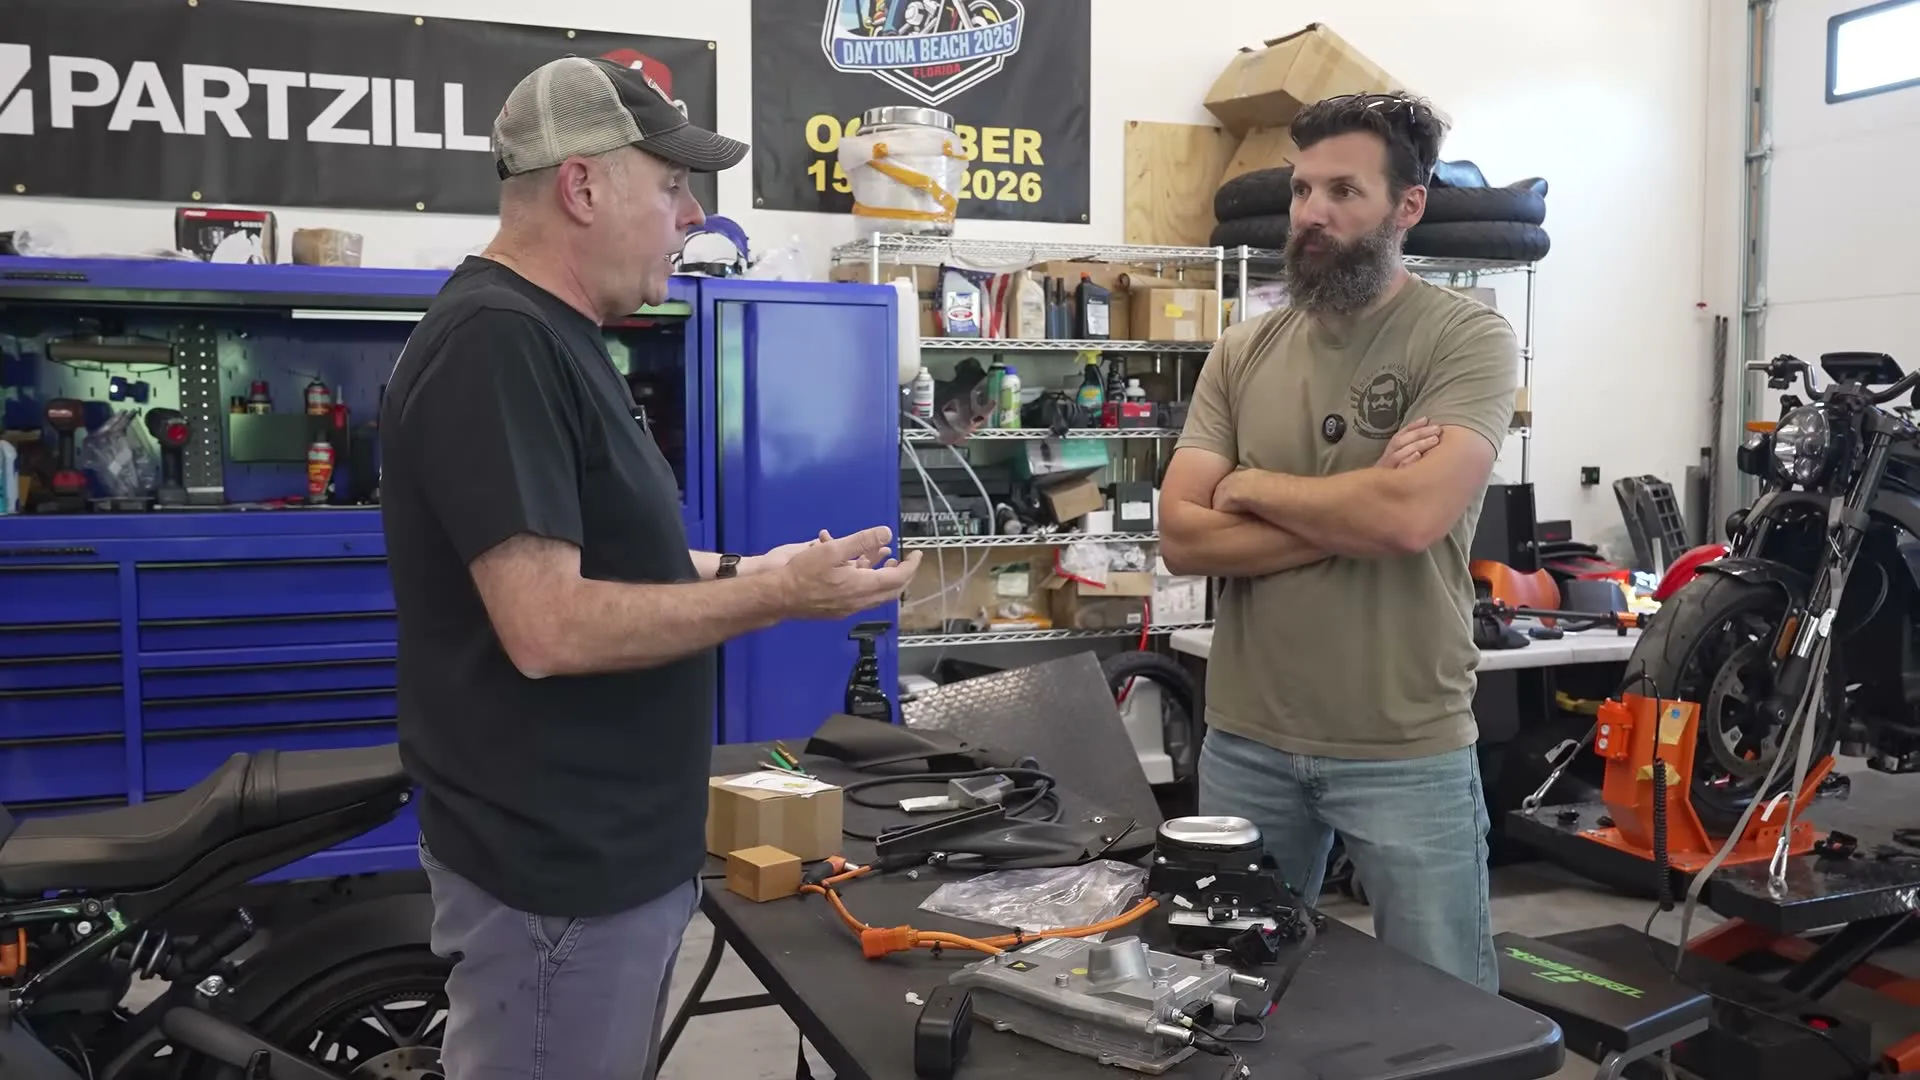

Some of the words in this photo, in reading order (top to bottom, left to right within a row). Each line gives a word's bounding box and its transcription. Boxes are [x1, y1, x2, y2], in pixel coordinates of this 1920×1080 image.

[842, 39, 916, 65] DAYTONA
[919, 33, 970, 62] BEACH
[973, 23, 1013, 54] 2026
[912, 63, 962, 78] FLORIDA
[48, 55, 494, 152] PARTZILL
[805, 114, 1044, 166] OBER
[959, 169, 1042, 203] 2026
